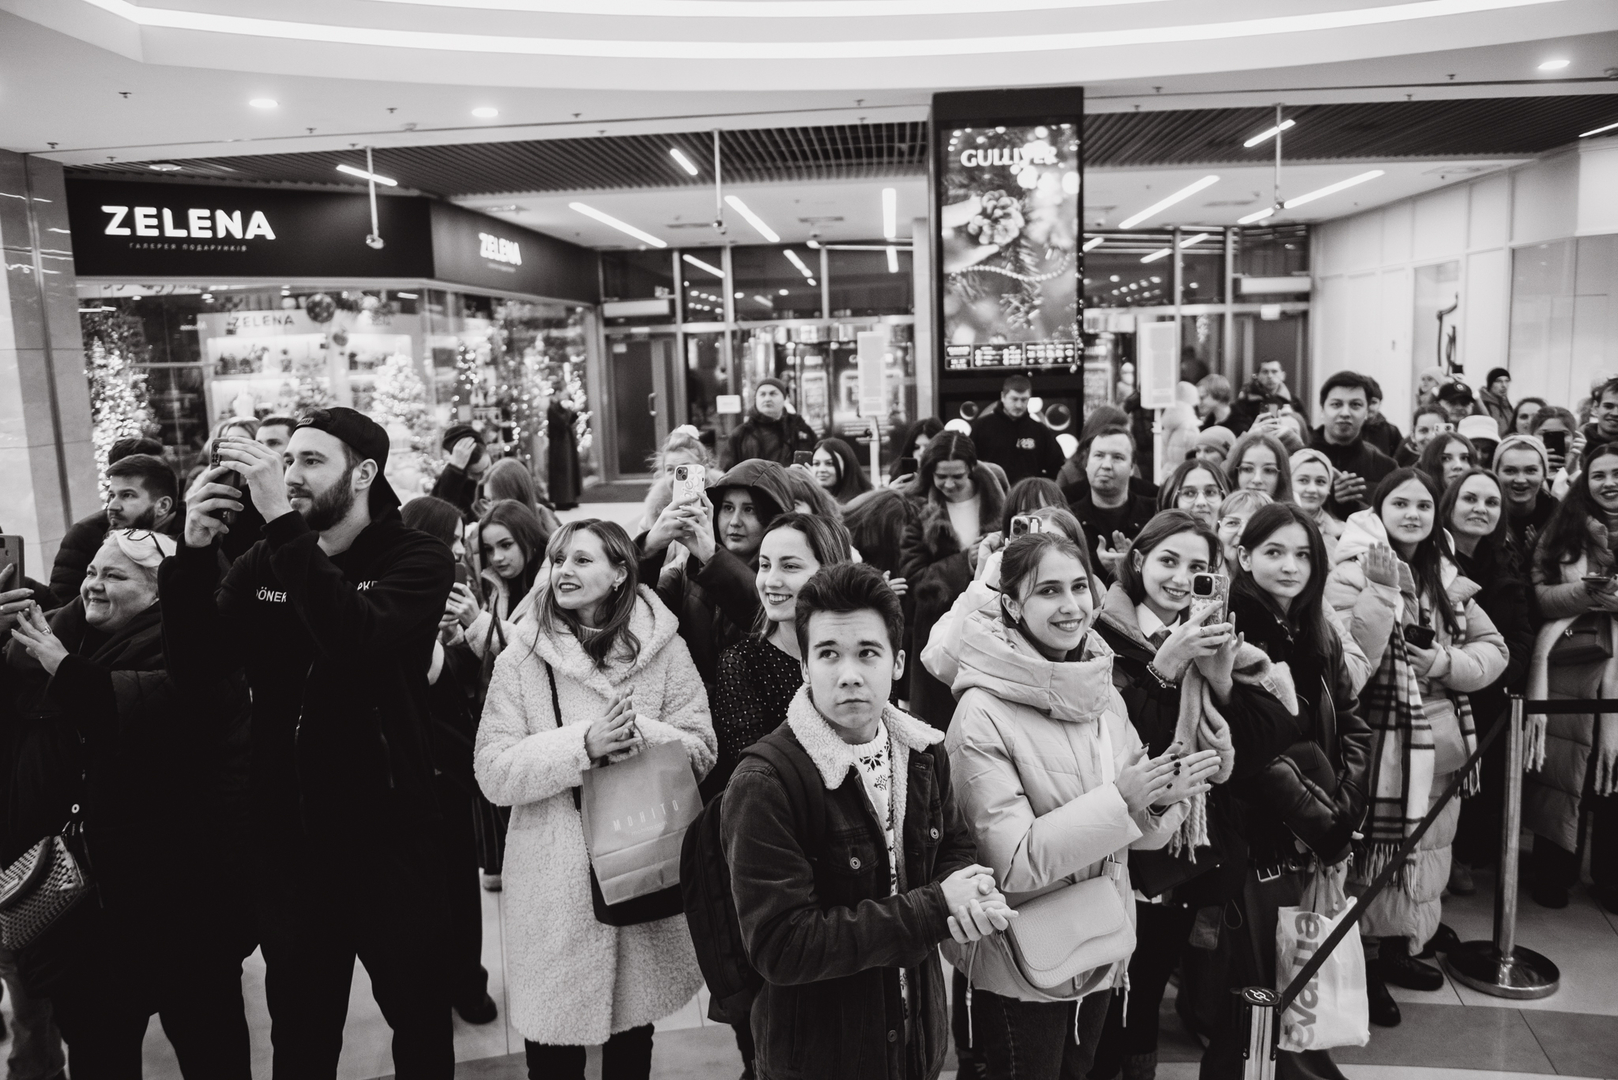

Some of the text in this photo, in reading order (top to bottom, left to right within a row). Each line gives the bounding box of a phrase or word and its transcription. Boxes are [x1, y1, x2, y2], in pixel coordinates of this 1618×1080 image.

[101, 205, 276, 240] ZELENA
[479, 232, 522, 266] ZELENA
[232, 315, 295, 328] ZELENA
[256, 586, 287, 603] ÖNER
[613, 799, 679, 832] MOHITO
